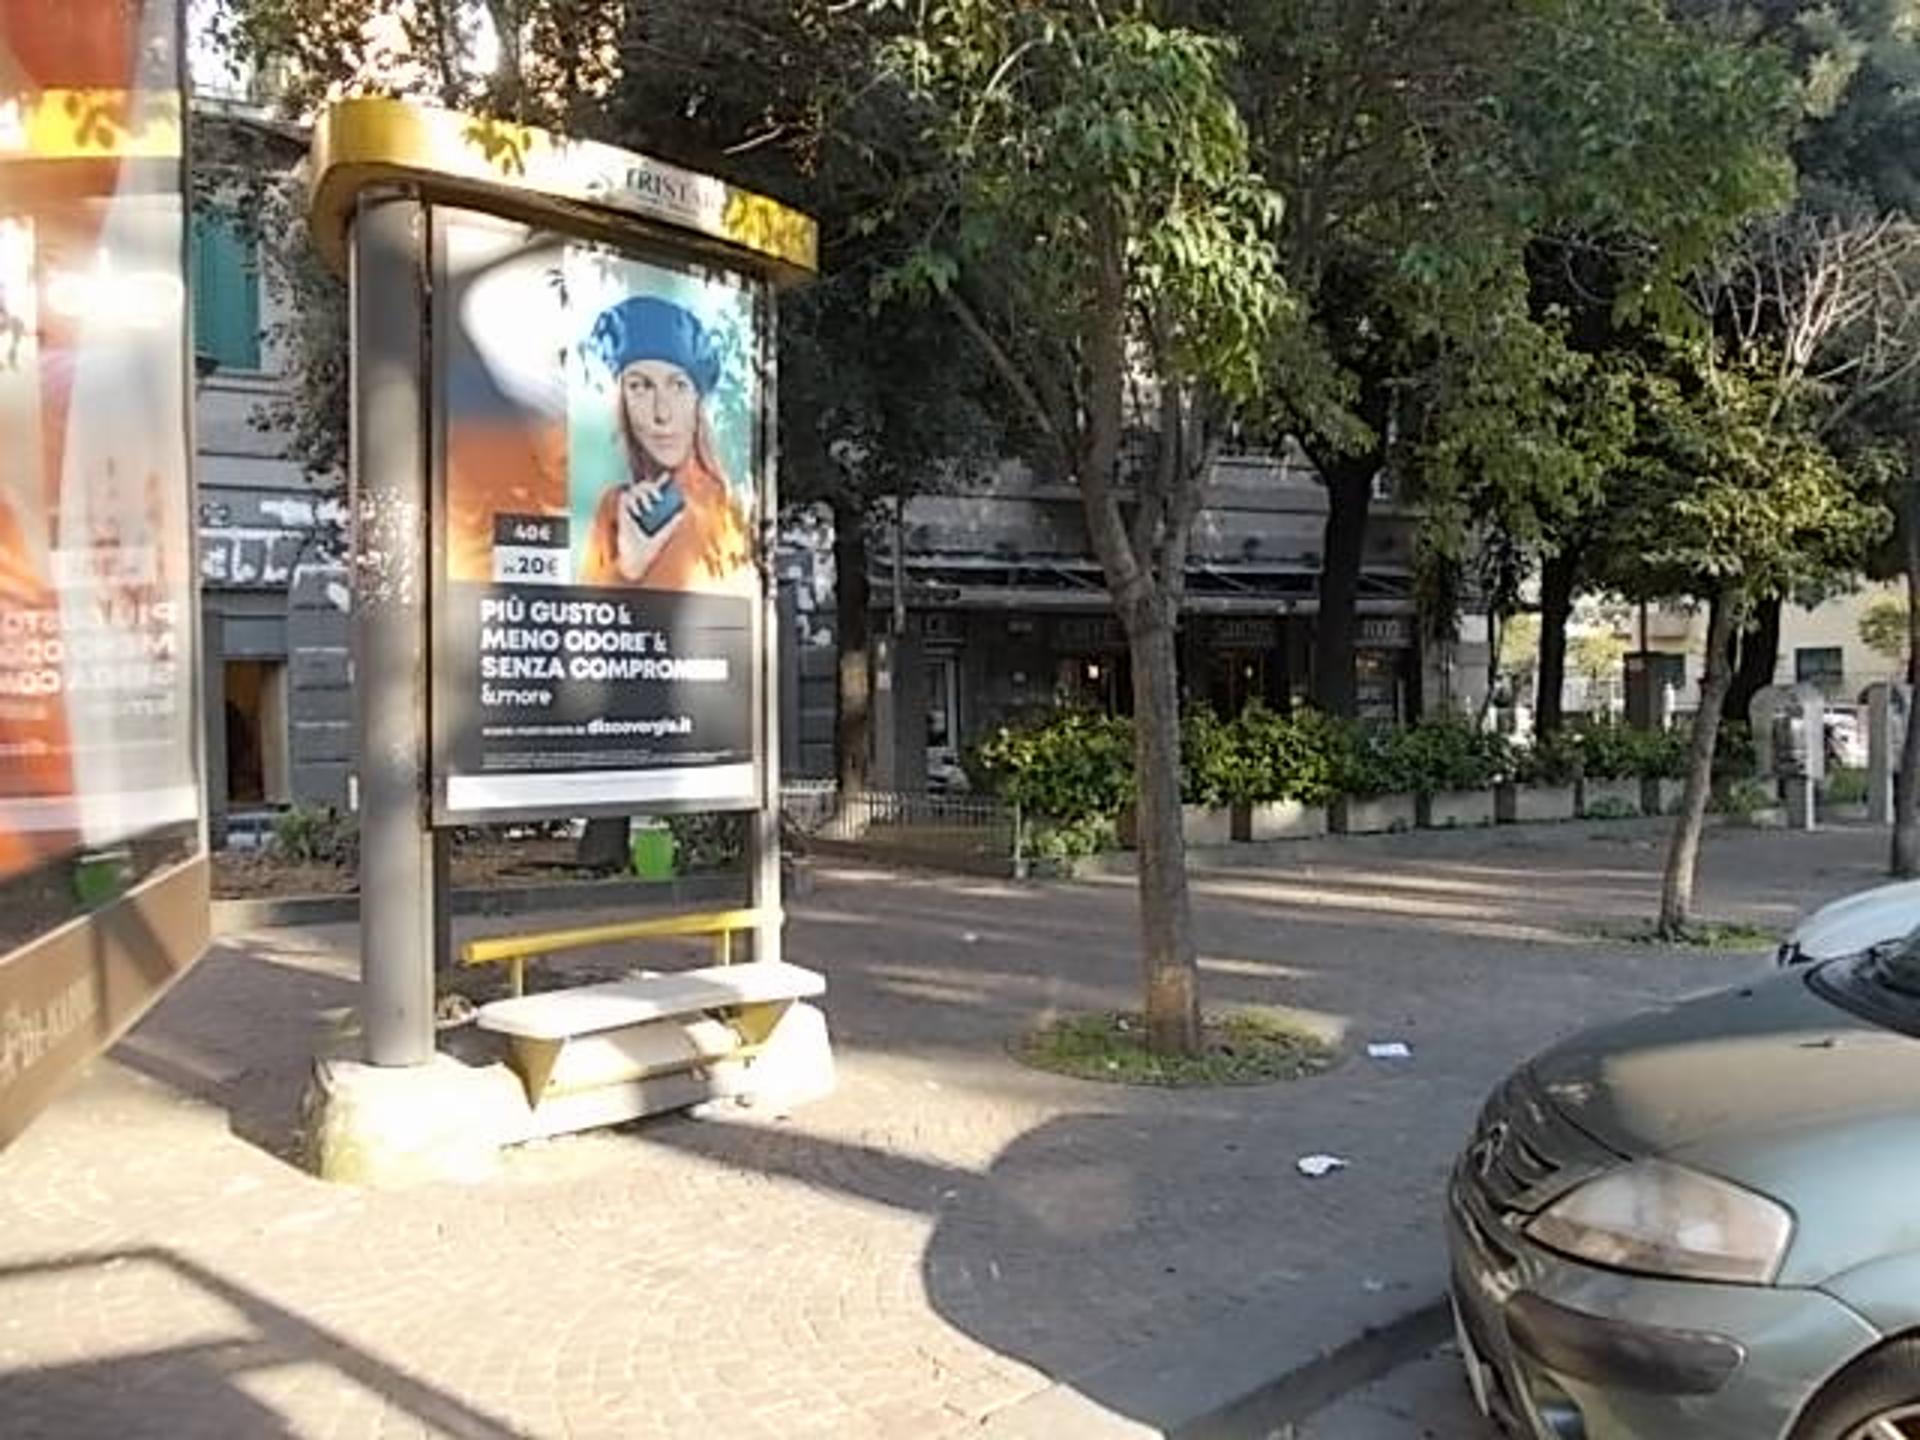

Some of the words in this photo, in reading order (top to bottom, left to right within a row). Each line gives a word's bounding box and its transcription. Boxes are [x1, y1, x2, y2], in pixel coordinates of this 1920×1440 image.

[480, 596, 524, 622] PIÙ
[530, 601, 616, 625] GUSTO
[480, 630, 560, 652] MENO
[481, 658, 566, 678] SENZA
[569, 657, 728, 681] COMPROM
